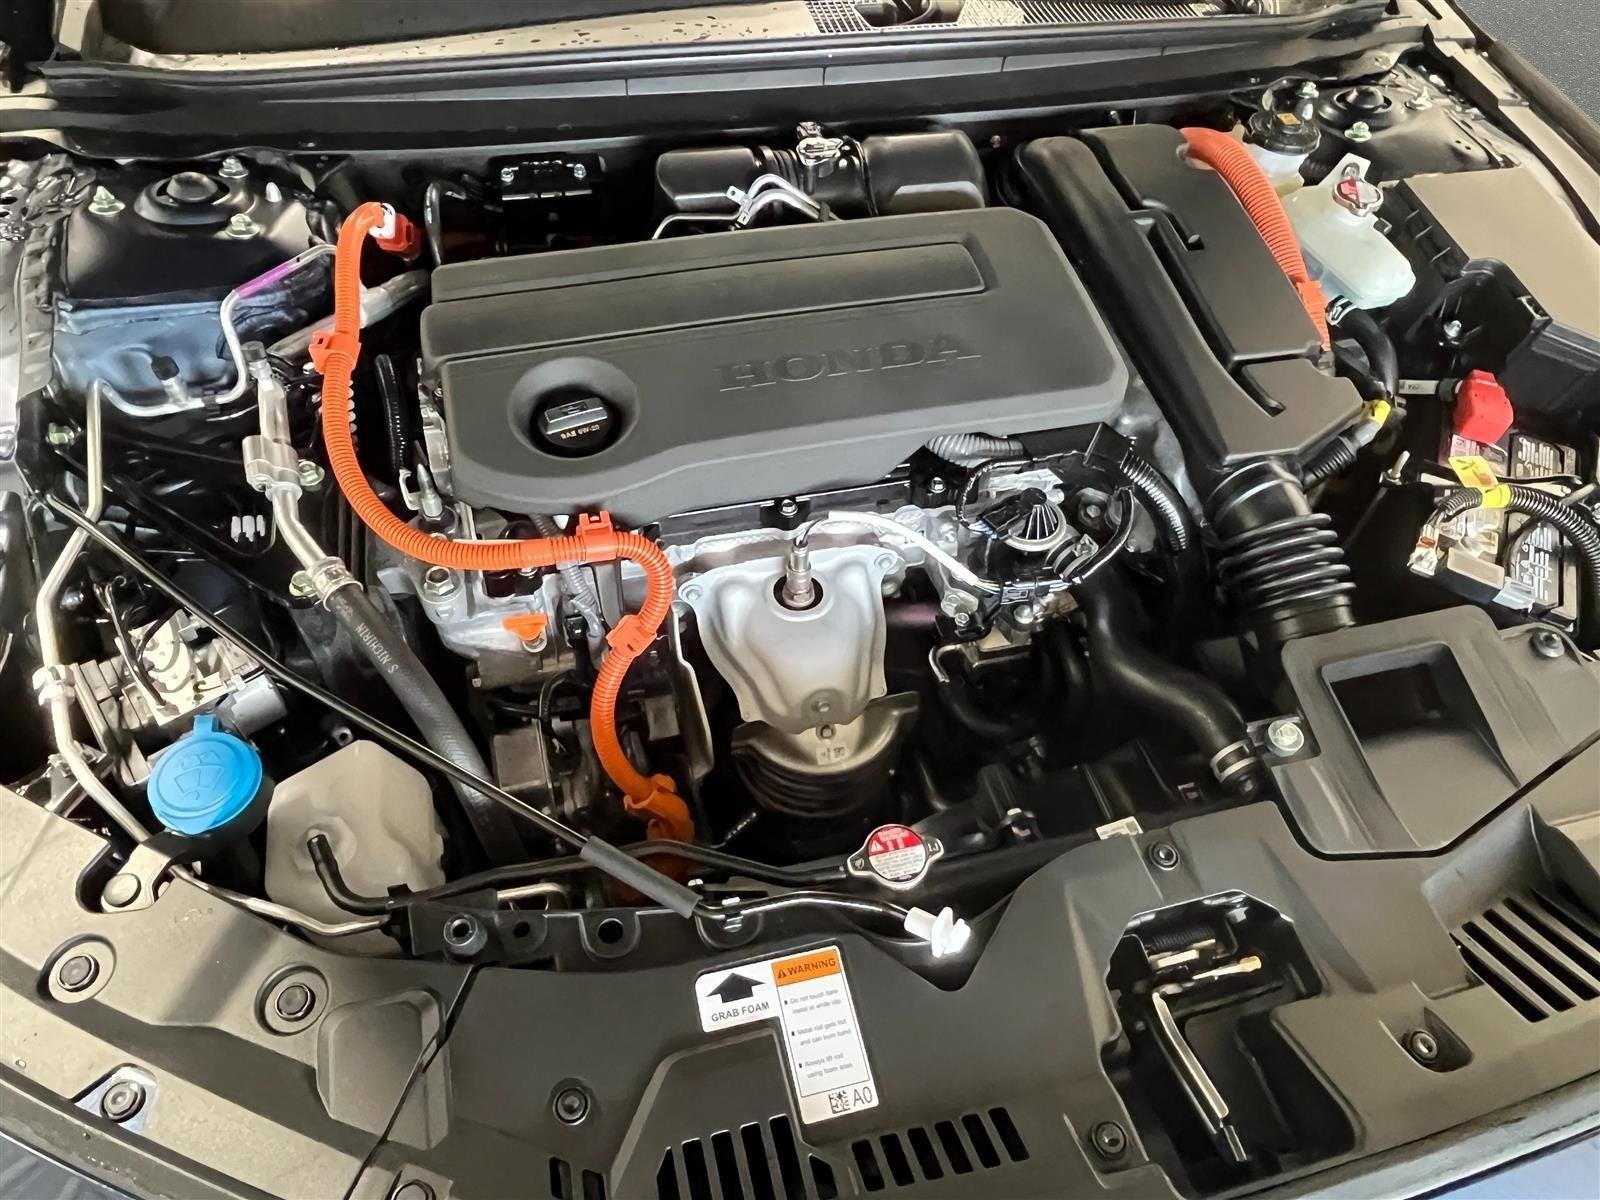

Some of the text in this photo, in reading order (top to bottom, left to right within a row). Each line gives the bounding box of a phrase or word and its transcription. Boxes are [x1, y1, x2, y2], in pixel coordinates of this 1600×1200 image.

[714, 334, 982, 392] HONDA
[355, 622, 393, 666] NICHIRIN
[787, 957, 837, 976] WARNING
[711, 1001, 770, 1022] GRAB FOAM
